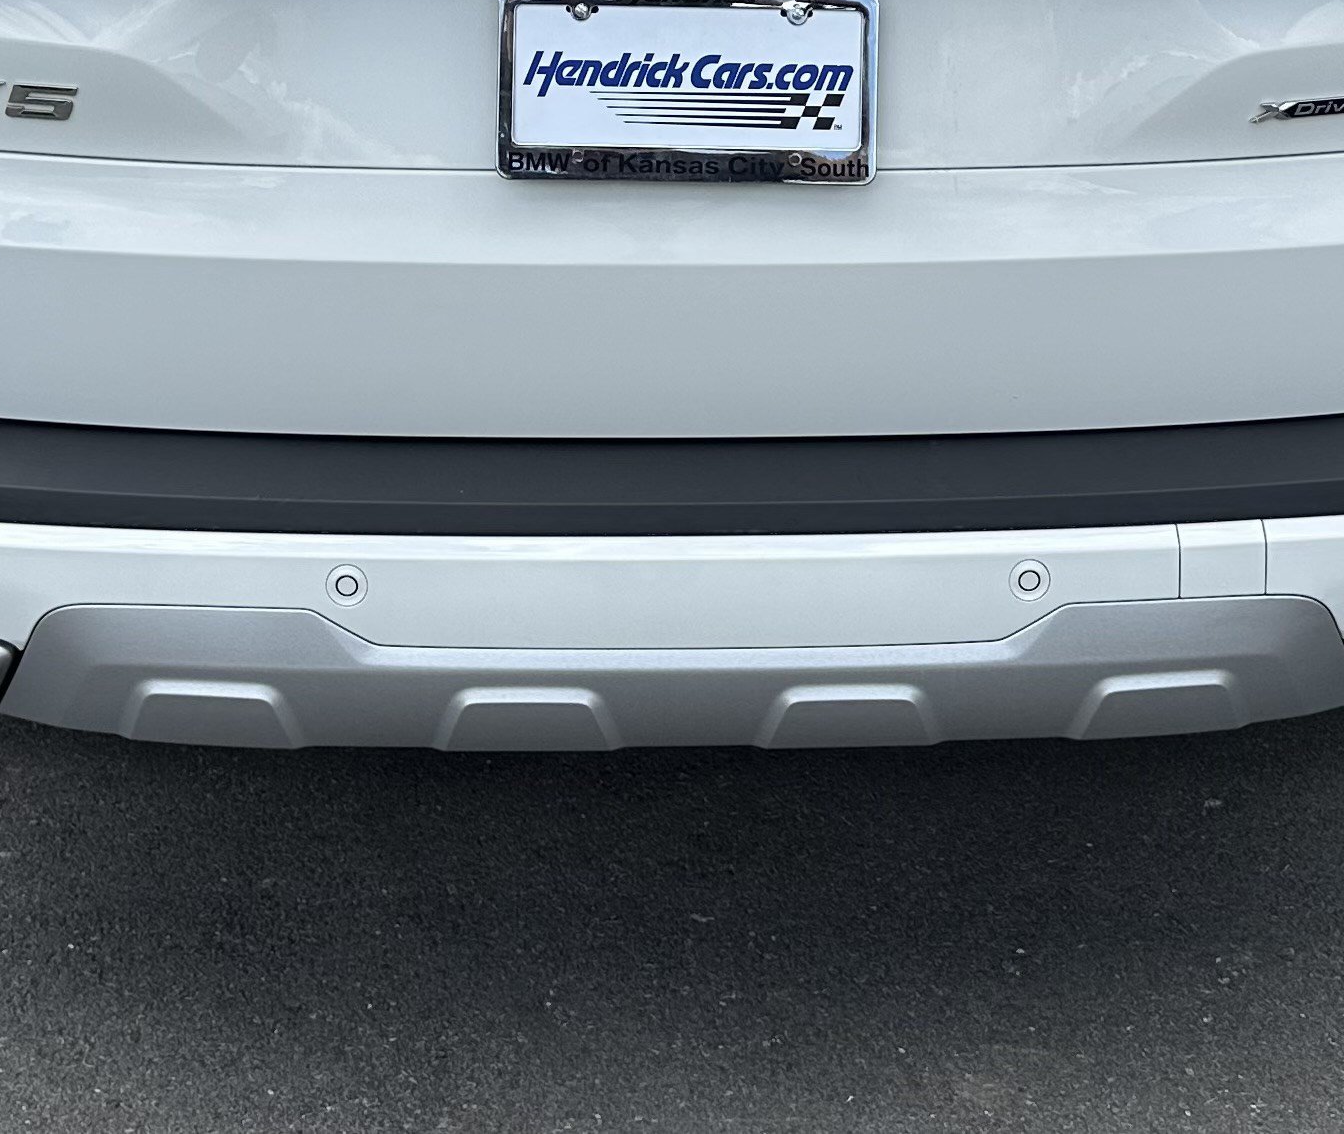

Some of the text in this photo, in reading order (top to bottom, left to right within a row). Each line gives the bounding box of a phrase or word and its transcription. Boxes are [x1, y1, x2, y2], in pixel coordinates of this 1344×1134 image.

[508, 152, 870, 184] BMW of Kansas City South
